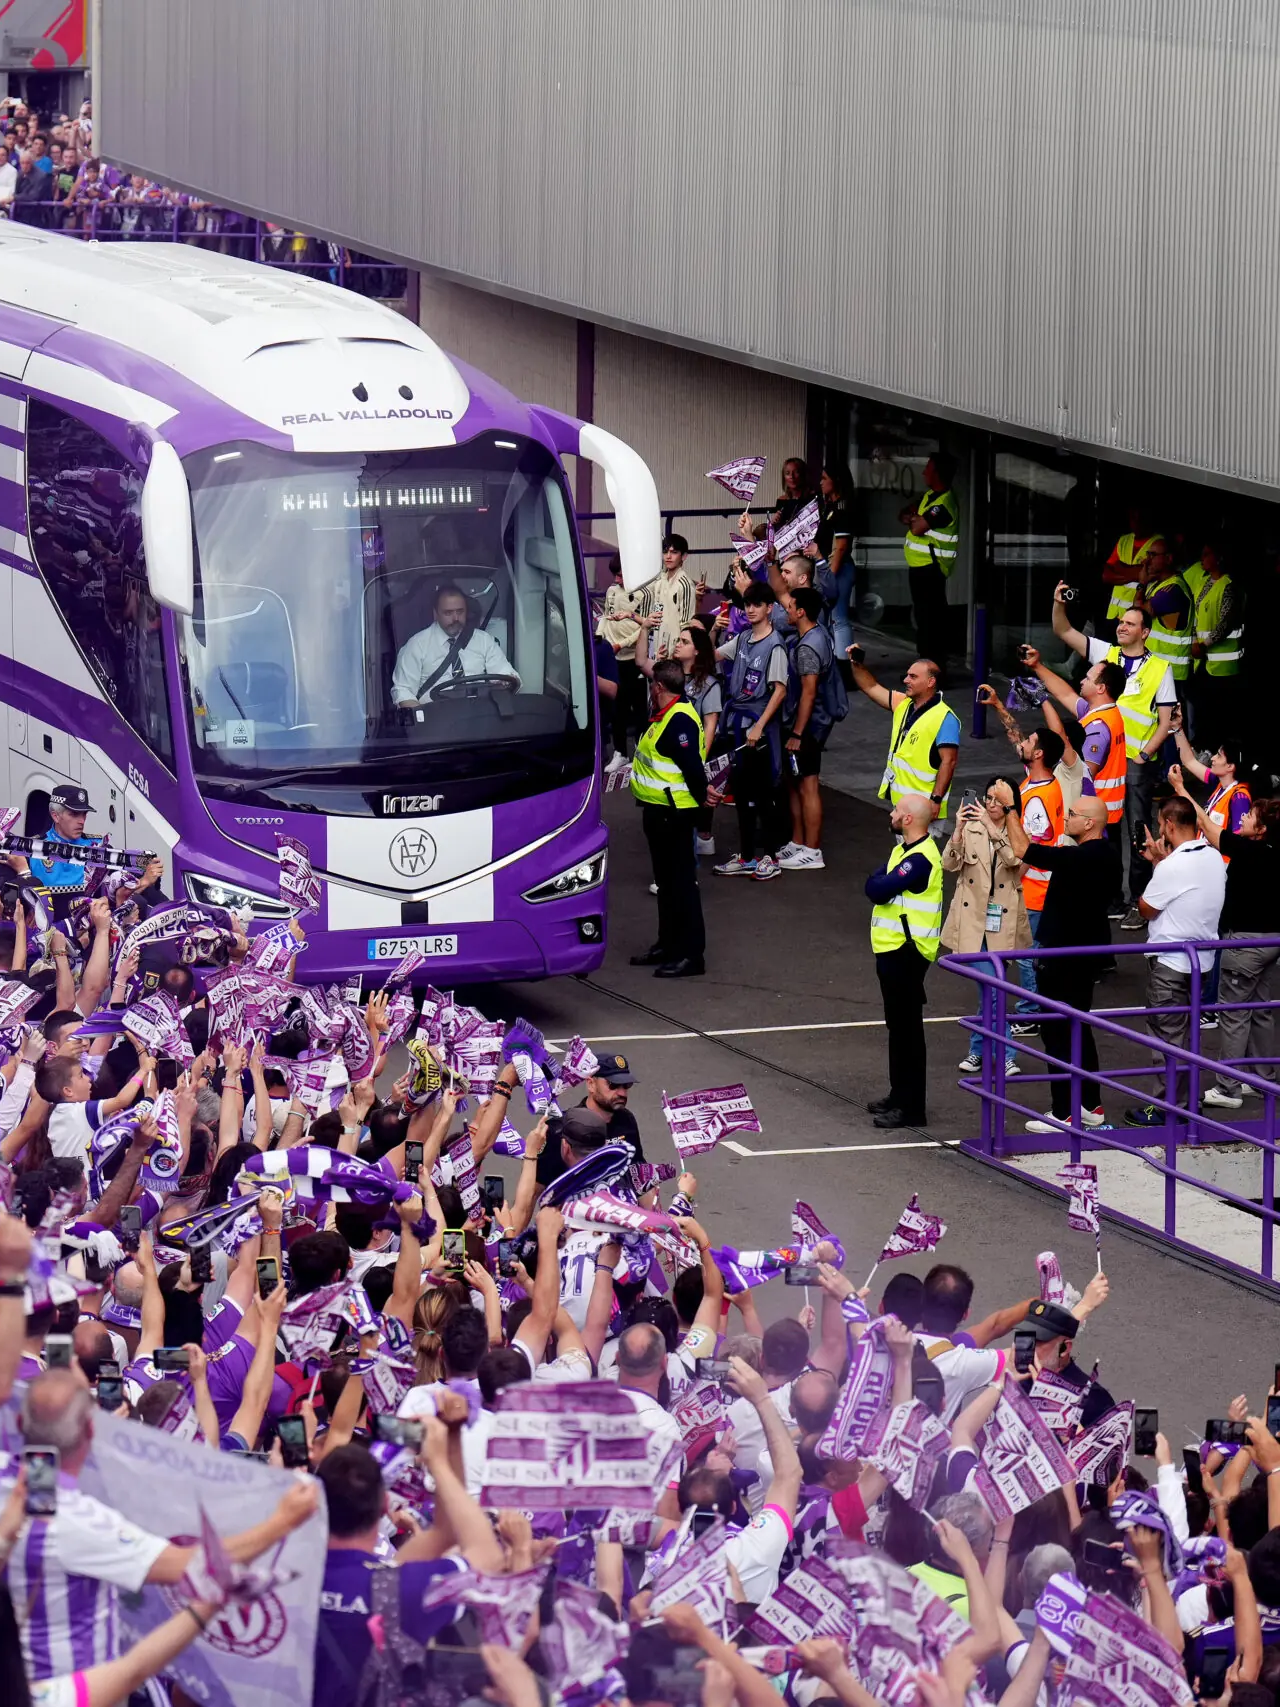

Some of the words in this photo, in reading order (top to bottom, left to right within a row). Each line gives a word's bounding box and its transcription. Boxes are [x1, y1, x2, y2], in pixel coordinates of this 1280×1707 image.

[281, 412, 334, 426] REAL
[337, 408, 454, 421] VALLADOLID
[128, 761, 150, 799] ECSA
[233, 816, 284, 826] VOLVO
[424, 937, 454, 954] LRS
